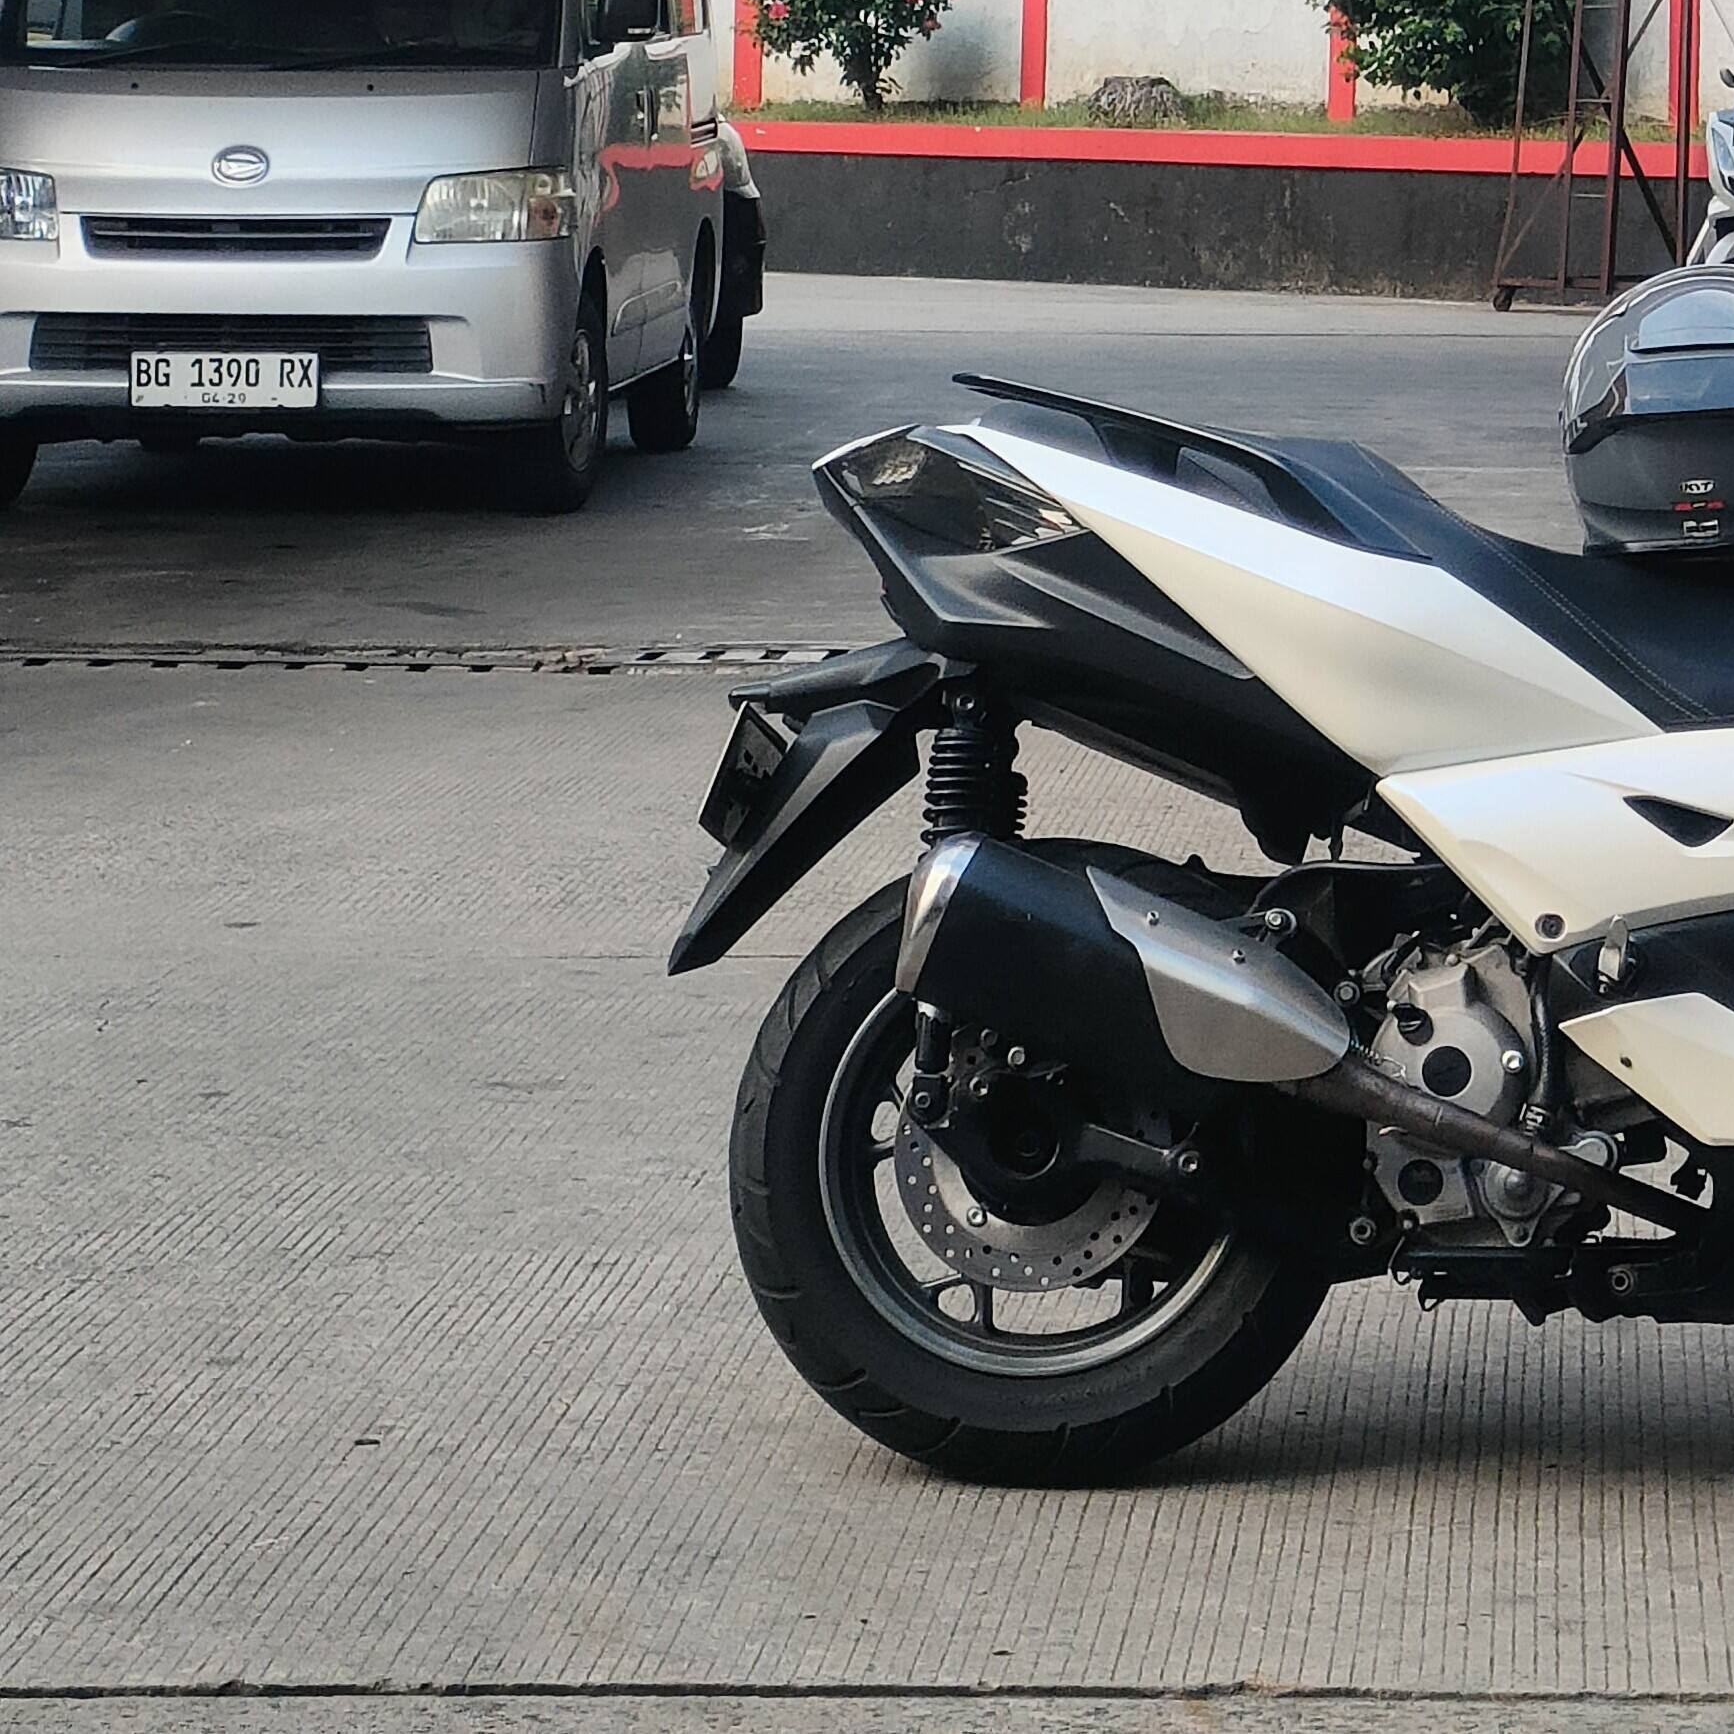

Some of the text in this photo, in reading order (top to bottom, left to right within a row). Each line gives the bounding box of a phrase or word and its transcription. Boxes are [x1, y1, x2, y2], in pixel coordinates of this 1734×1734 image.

[136, 358, 313, 388] BG 1390 RX
